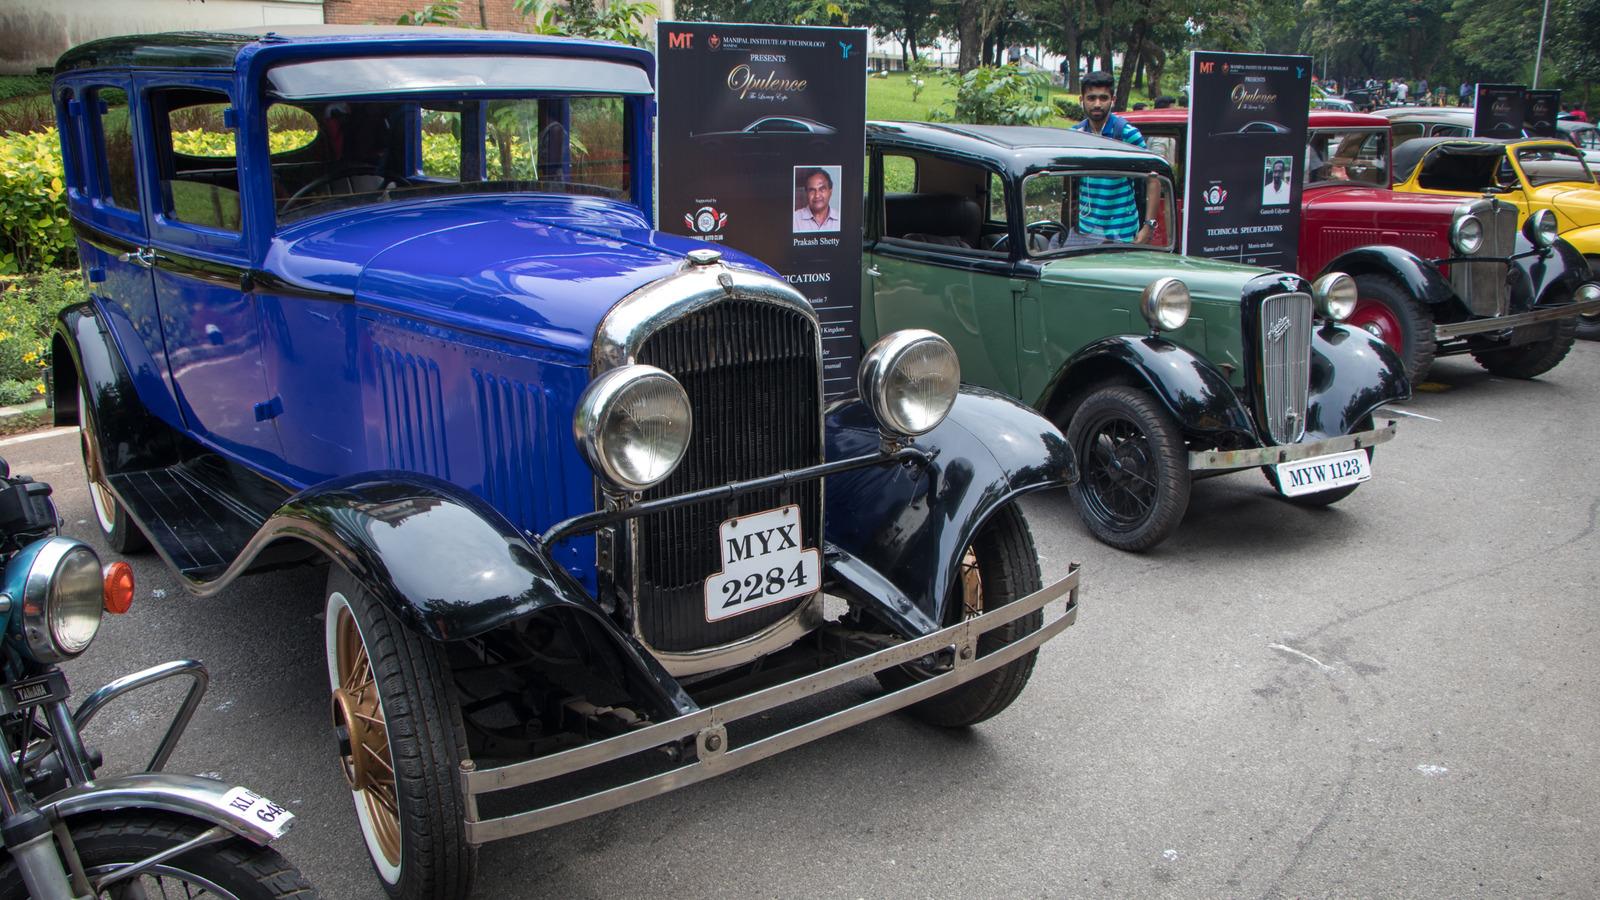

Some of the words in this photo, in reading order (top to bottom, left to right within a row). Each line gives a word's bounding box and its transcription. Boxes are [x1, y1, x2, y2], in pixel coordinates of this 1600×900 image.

[750, 54, 786, 62] PRESENTS
[727, 64, 808, 100] Opulence
[1207, 227, 1239, 236] TECHNICAL
[1240, 225, 1283, 234] SPECIFICATIONS
[793, 237, 818, 247] Prakash
[820, 237, 840, 247] Shetty
[1289, 464, 1327, 488] MYW
[1329, 458, 1360, 480] 1123
[727, 523, 797, 564] MYX
[722, 560, 808, 609] 2284
[17, 683, 47, 700] YAMAHA
[229, 796, 255, 812] KL
